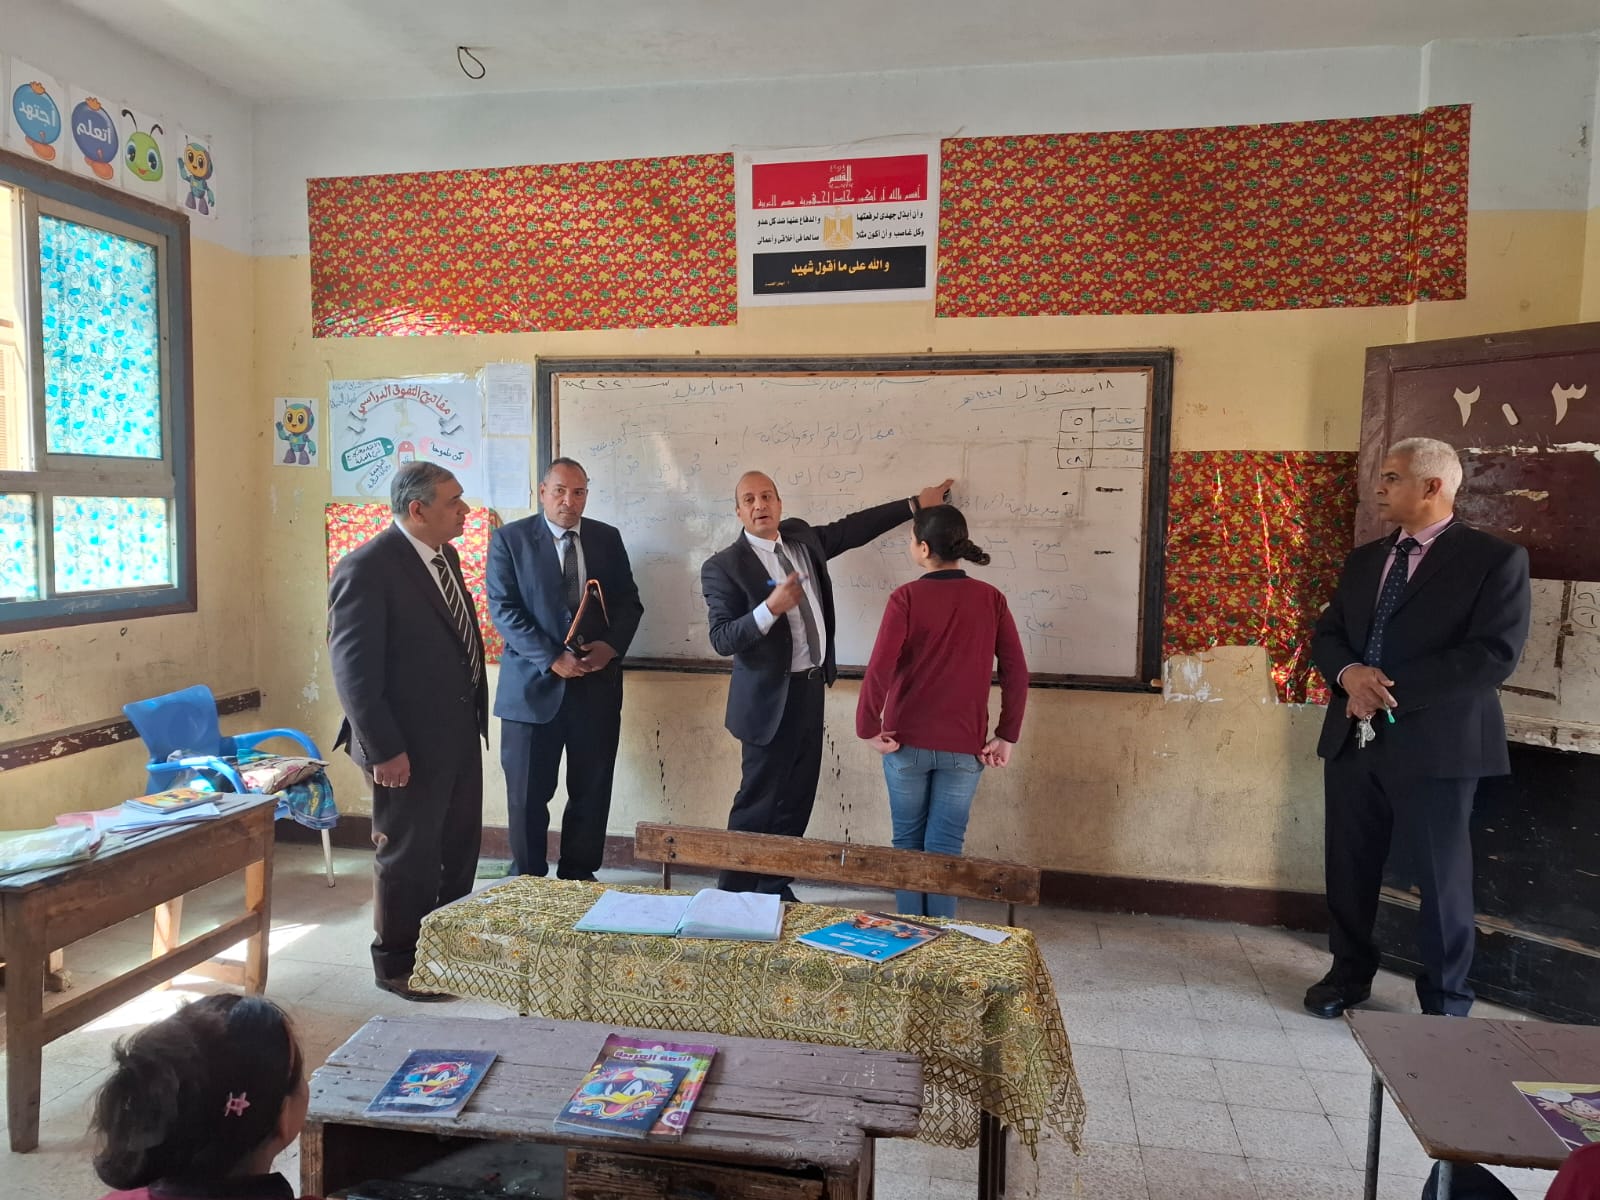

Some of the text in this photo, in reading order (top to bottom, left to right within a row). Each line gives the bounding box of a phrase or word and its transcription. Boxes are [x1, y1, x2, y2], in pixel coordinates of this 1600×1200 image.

[19, 102, 56, 126] اجتهد
[791, 260, 814, 277] شهيد
[392, 384, 422, 399] التفوق
